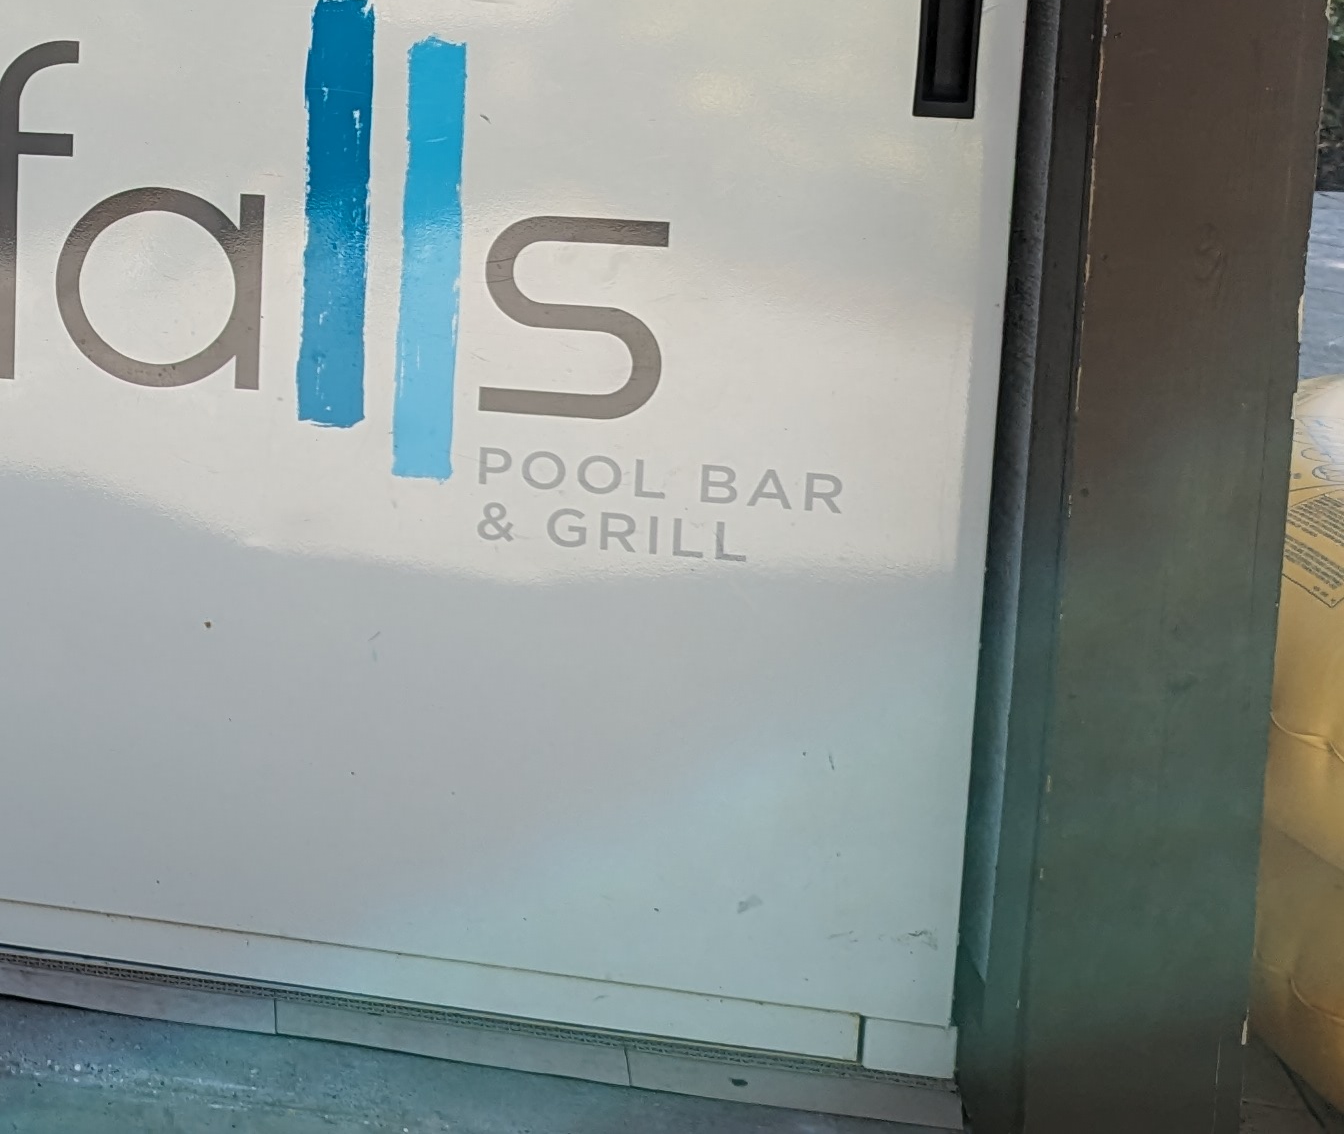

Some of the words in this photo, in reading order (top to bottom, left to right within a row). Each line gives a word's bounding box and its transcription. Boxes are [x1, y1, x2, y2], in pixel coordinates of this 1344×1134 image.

[477, 446, 666, 501] POOL
[699, 464, 846, 515] BAR
[477, 502, 514, 542] &
[546, 507, 748, 562] GRILL
